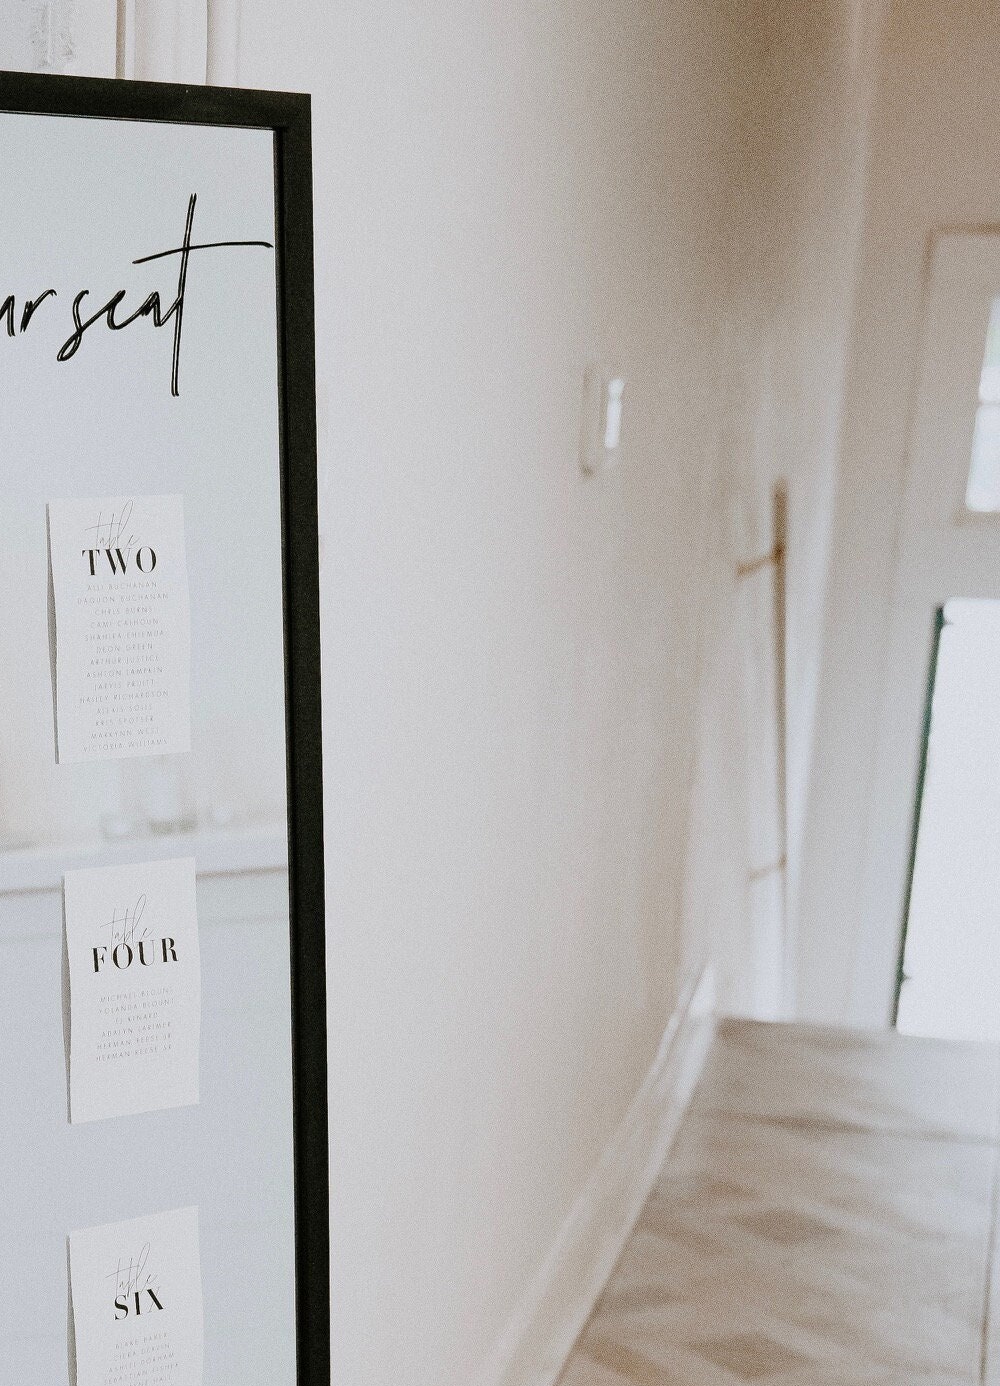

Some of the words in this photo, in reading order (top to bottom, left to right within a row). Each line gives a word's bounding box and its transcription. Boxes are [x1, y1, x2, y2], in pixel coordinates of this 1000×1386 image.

[56, 192, 274, 397] seat
[82, 546, 157, 576] TWO
[113, 690, 169, 701] RICHARDSON
[91, 937, 179, 973] FOUR
[114, 1287, 164, 1320] SIX
